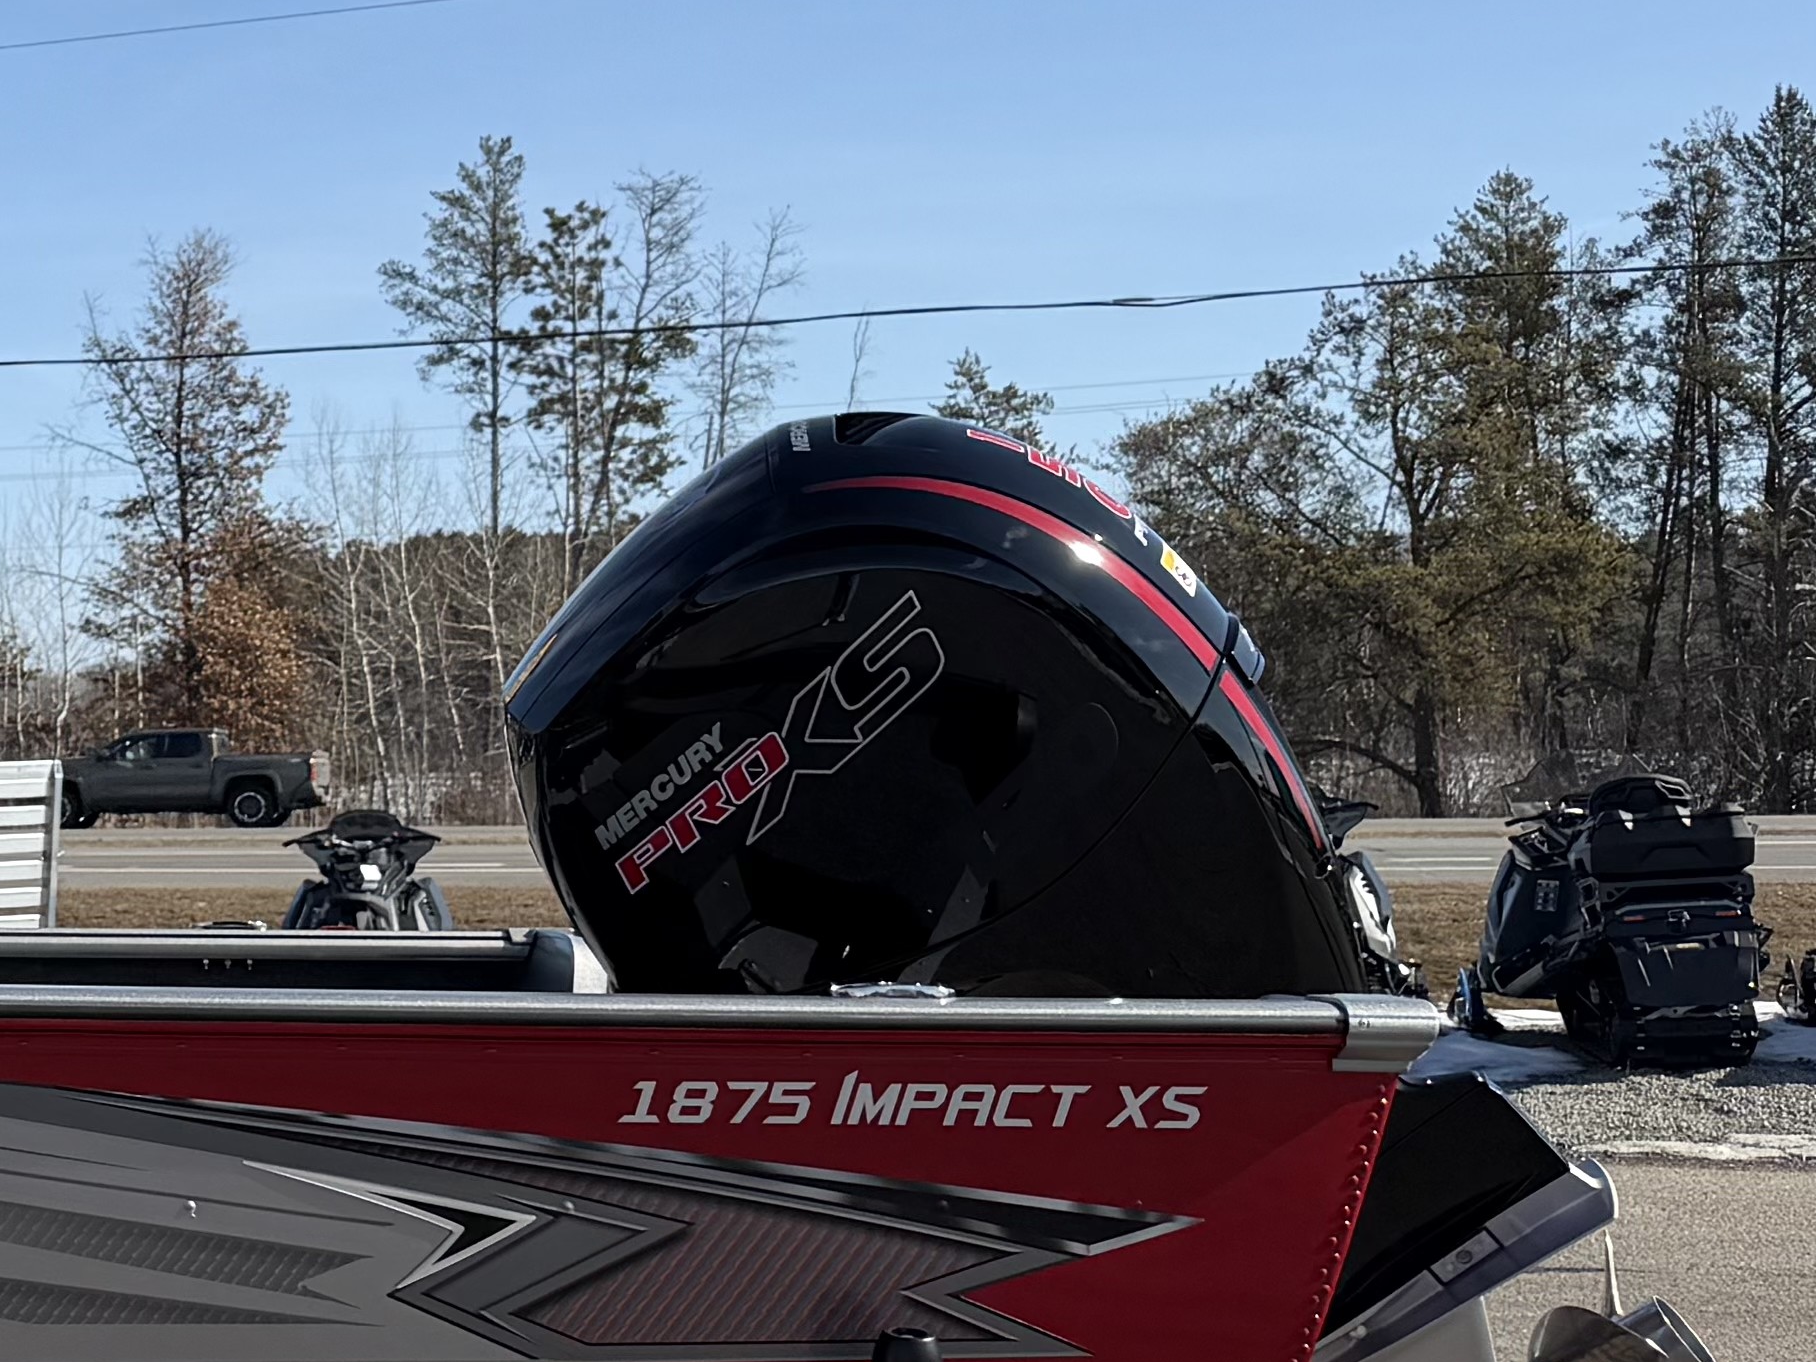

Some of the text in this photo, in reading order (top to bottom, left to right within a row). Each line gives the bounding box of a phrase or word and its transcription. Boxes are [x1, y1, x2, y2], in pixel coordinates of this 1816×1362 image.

[593, 721, 723, 851] MERCURY
[615, 589, 945, 895] PRO XS
[617, 1080, 816, 1125] 1875
[1105, 1085, 1209, 1130] XS
